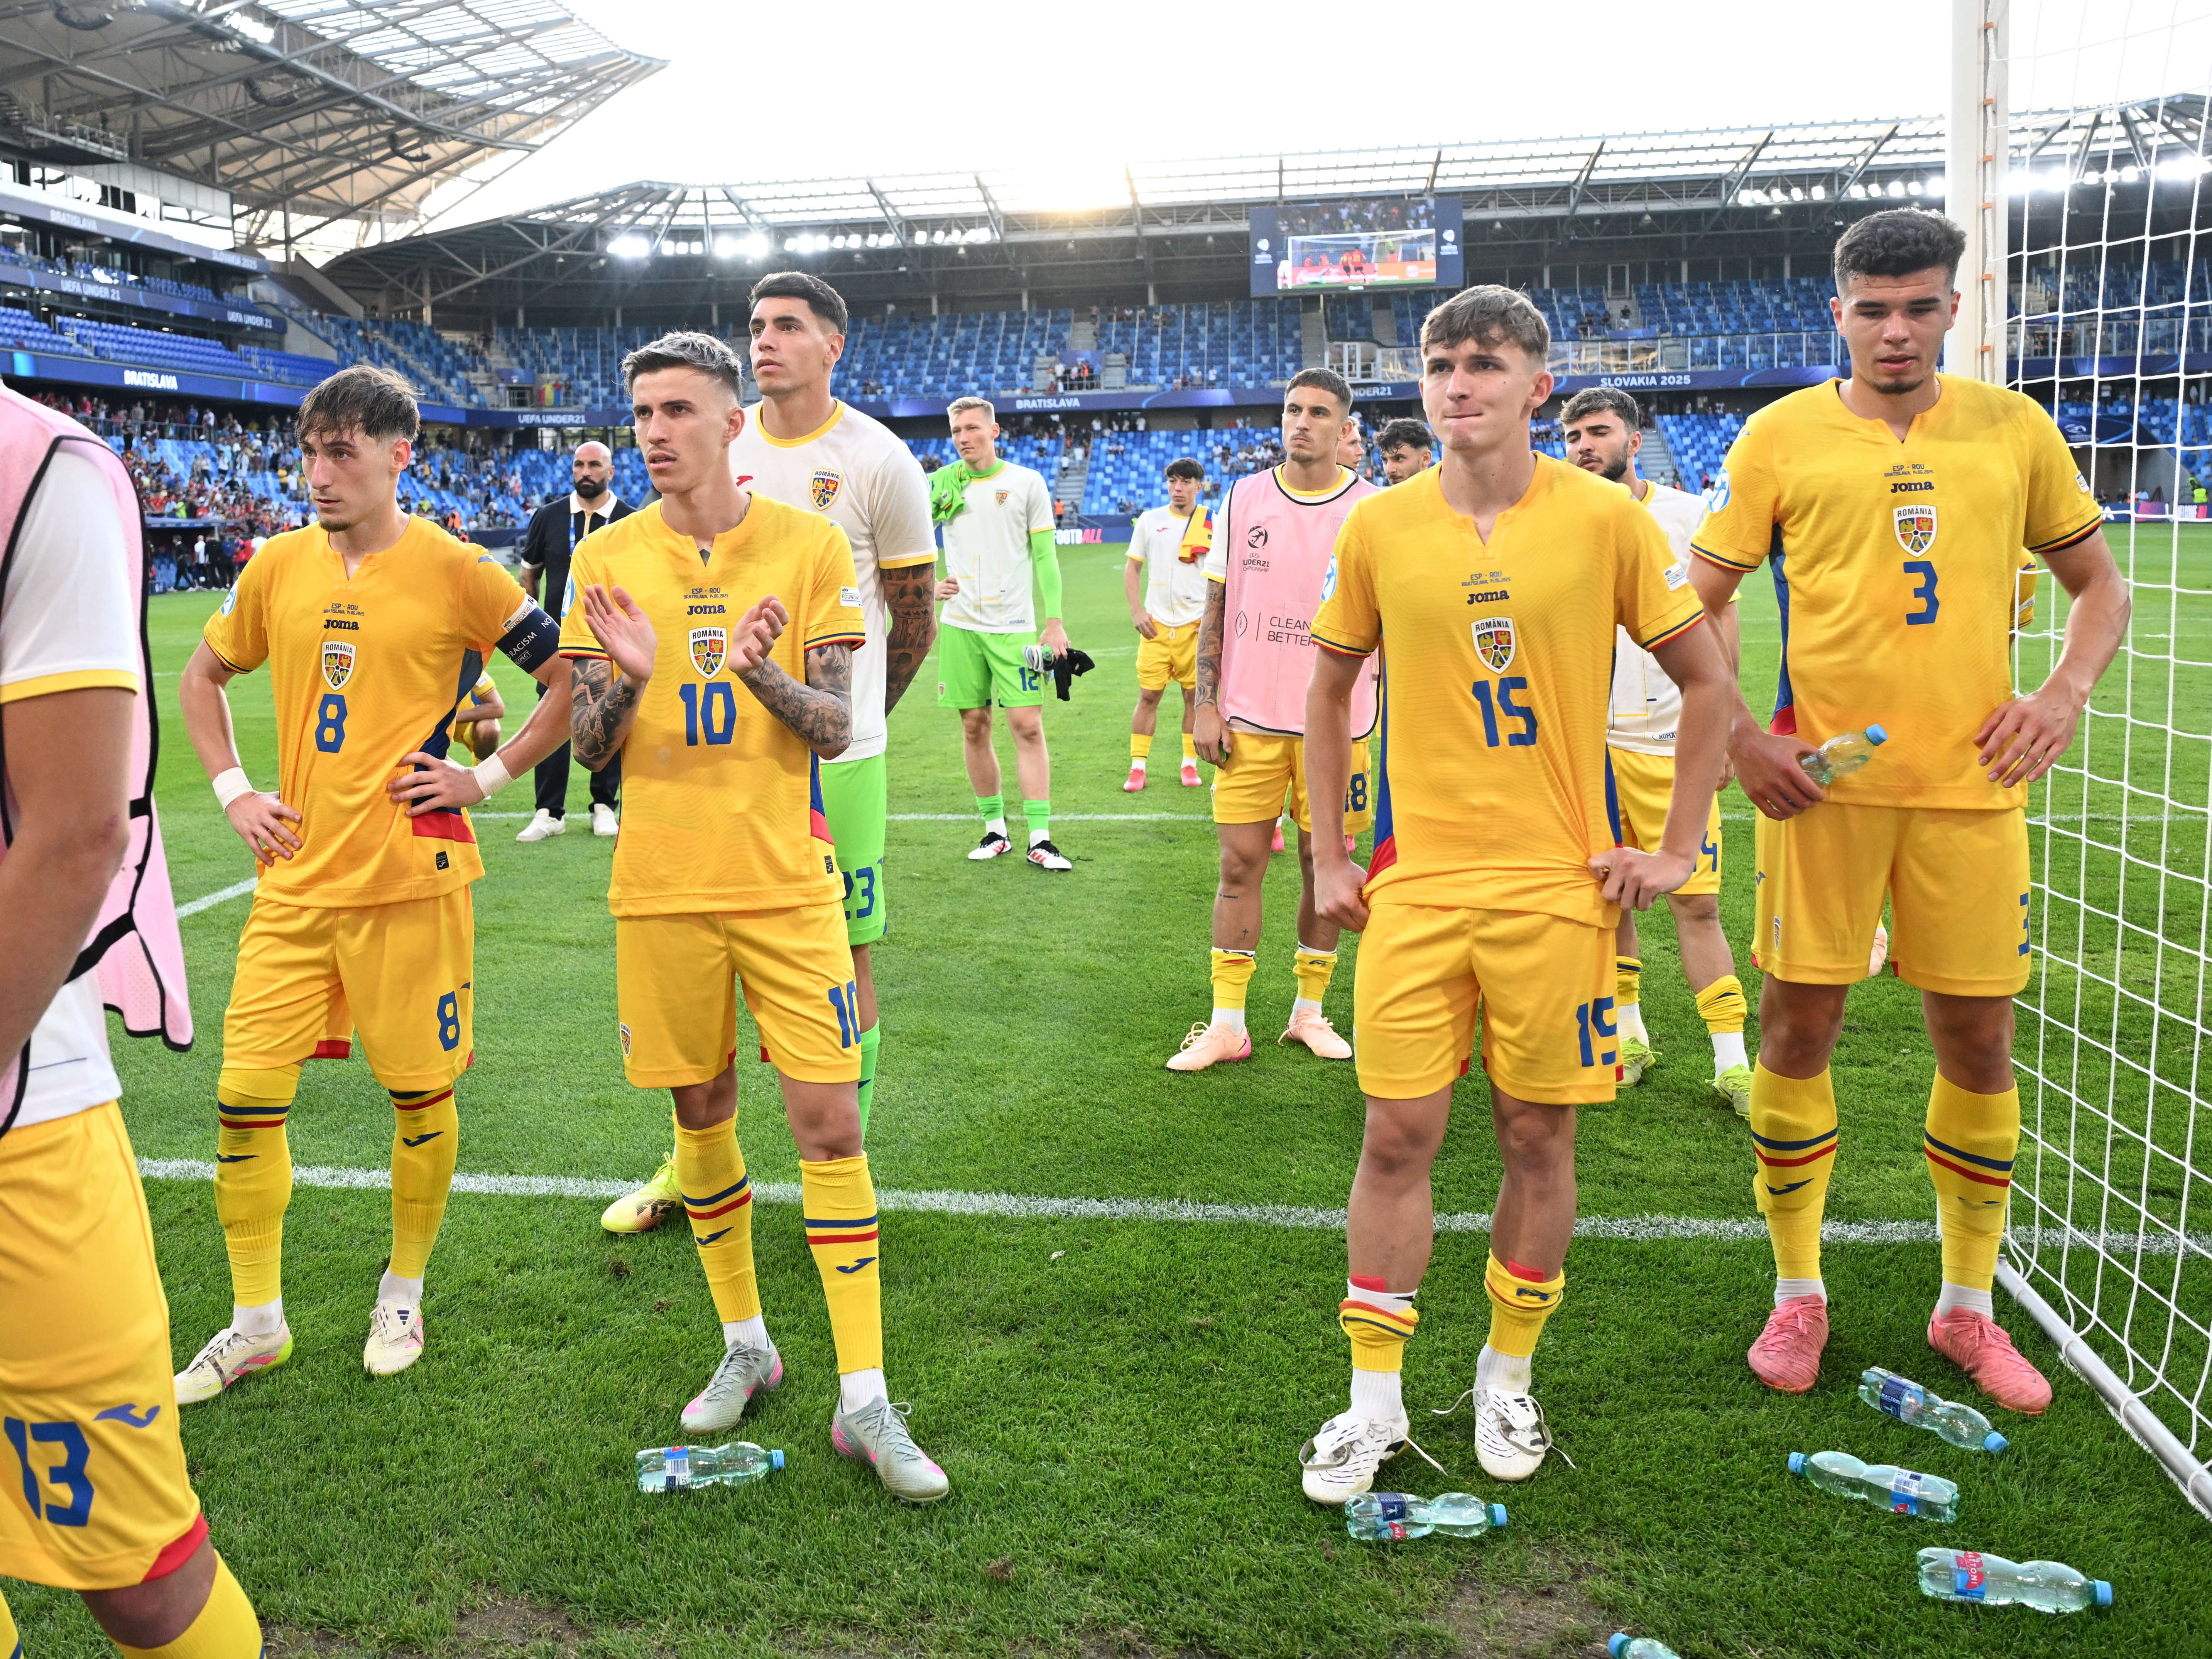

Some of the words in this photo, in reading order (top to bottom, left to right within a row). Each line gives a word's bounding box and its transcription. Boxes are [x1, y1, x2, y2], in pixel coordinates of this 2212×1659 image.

[111, 289, 120, 301] 21
[124, 370, 178, 390] BRATISLAVA
[1601, 375, 1657, 387] SLOVAKIA
[1660, 375, 1691, 385] 2025
[1353, 386, 1392, 397] NDER21
[1016, 397, 1080, 409] BRATISLAVA
[518, 414, 541, 424] UEFA
[815, 471, 839, 479] ROMÂNIA
[1898, 506, 1932, 517] ROMÂNIA
[1903, 561, 1940, 625] 3
[1270, 617, 1311, 630] CLEAN
[1475, 619, 1509, 632] ROMÂNIA
[693, 628, 723, 639] ROMÂNIA
[325, 643, 353, 654] ROMÂNIA
[509, 632, 537, 658] RACISM
[1019, 667, 1038, 691] 12
[679, 682, 737, 746] 10
[1472, 677, 1538, 747] 15
[315, 693, 348, 753] 8
[437, 990, 460, 1052] 8
[4, 1416, 94, 1527] 13
